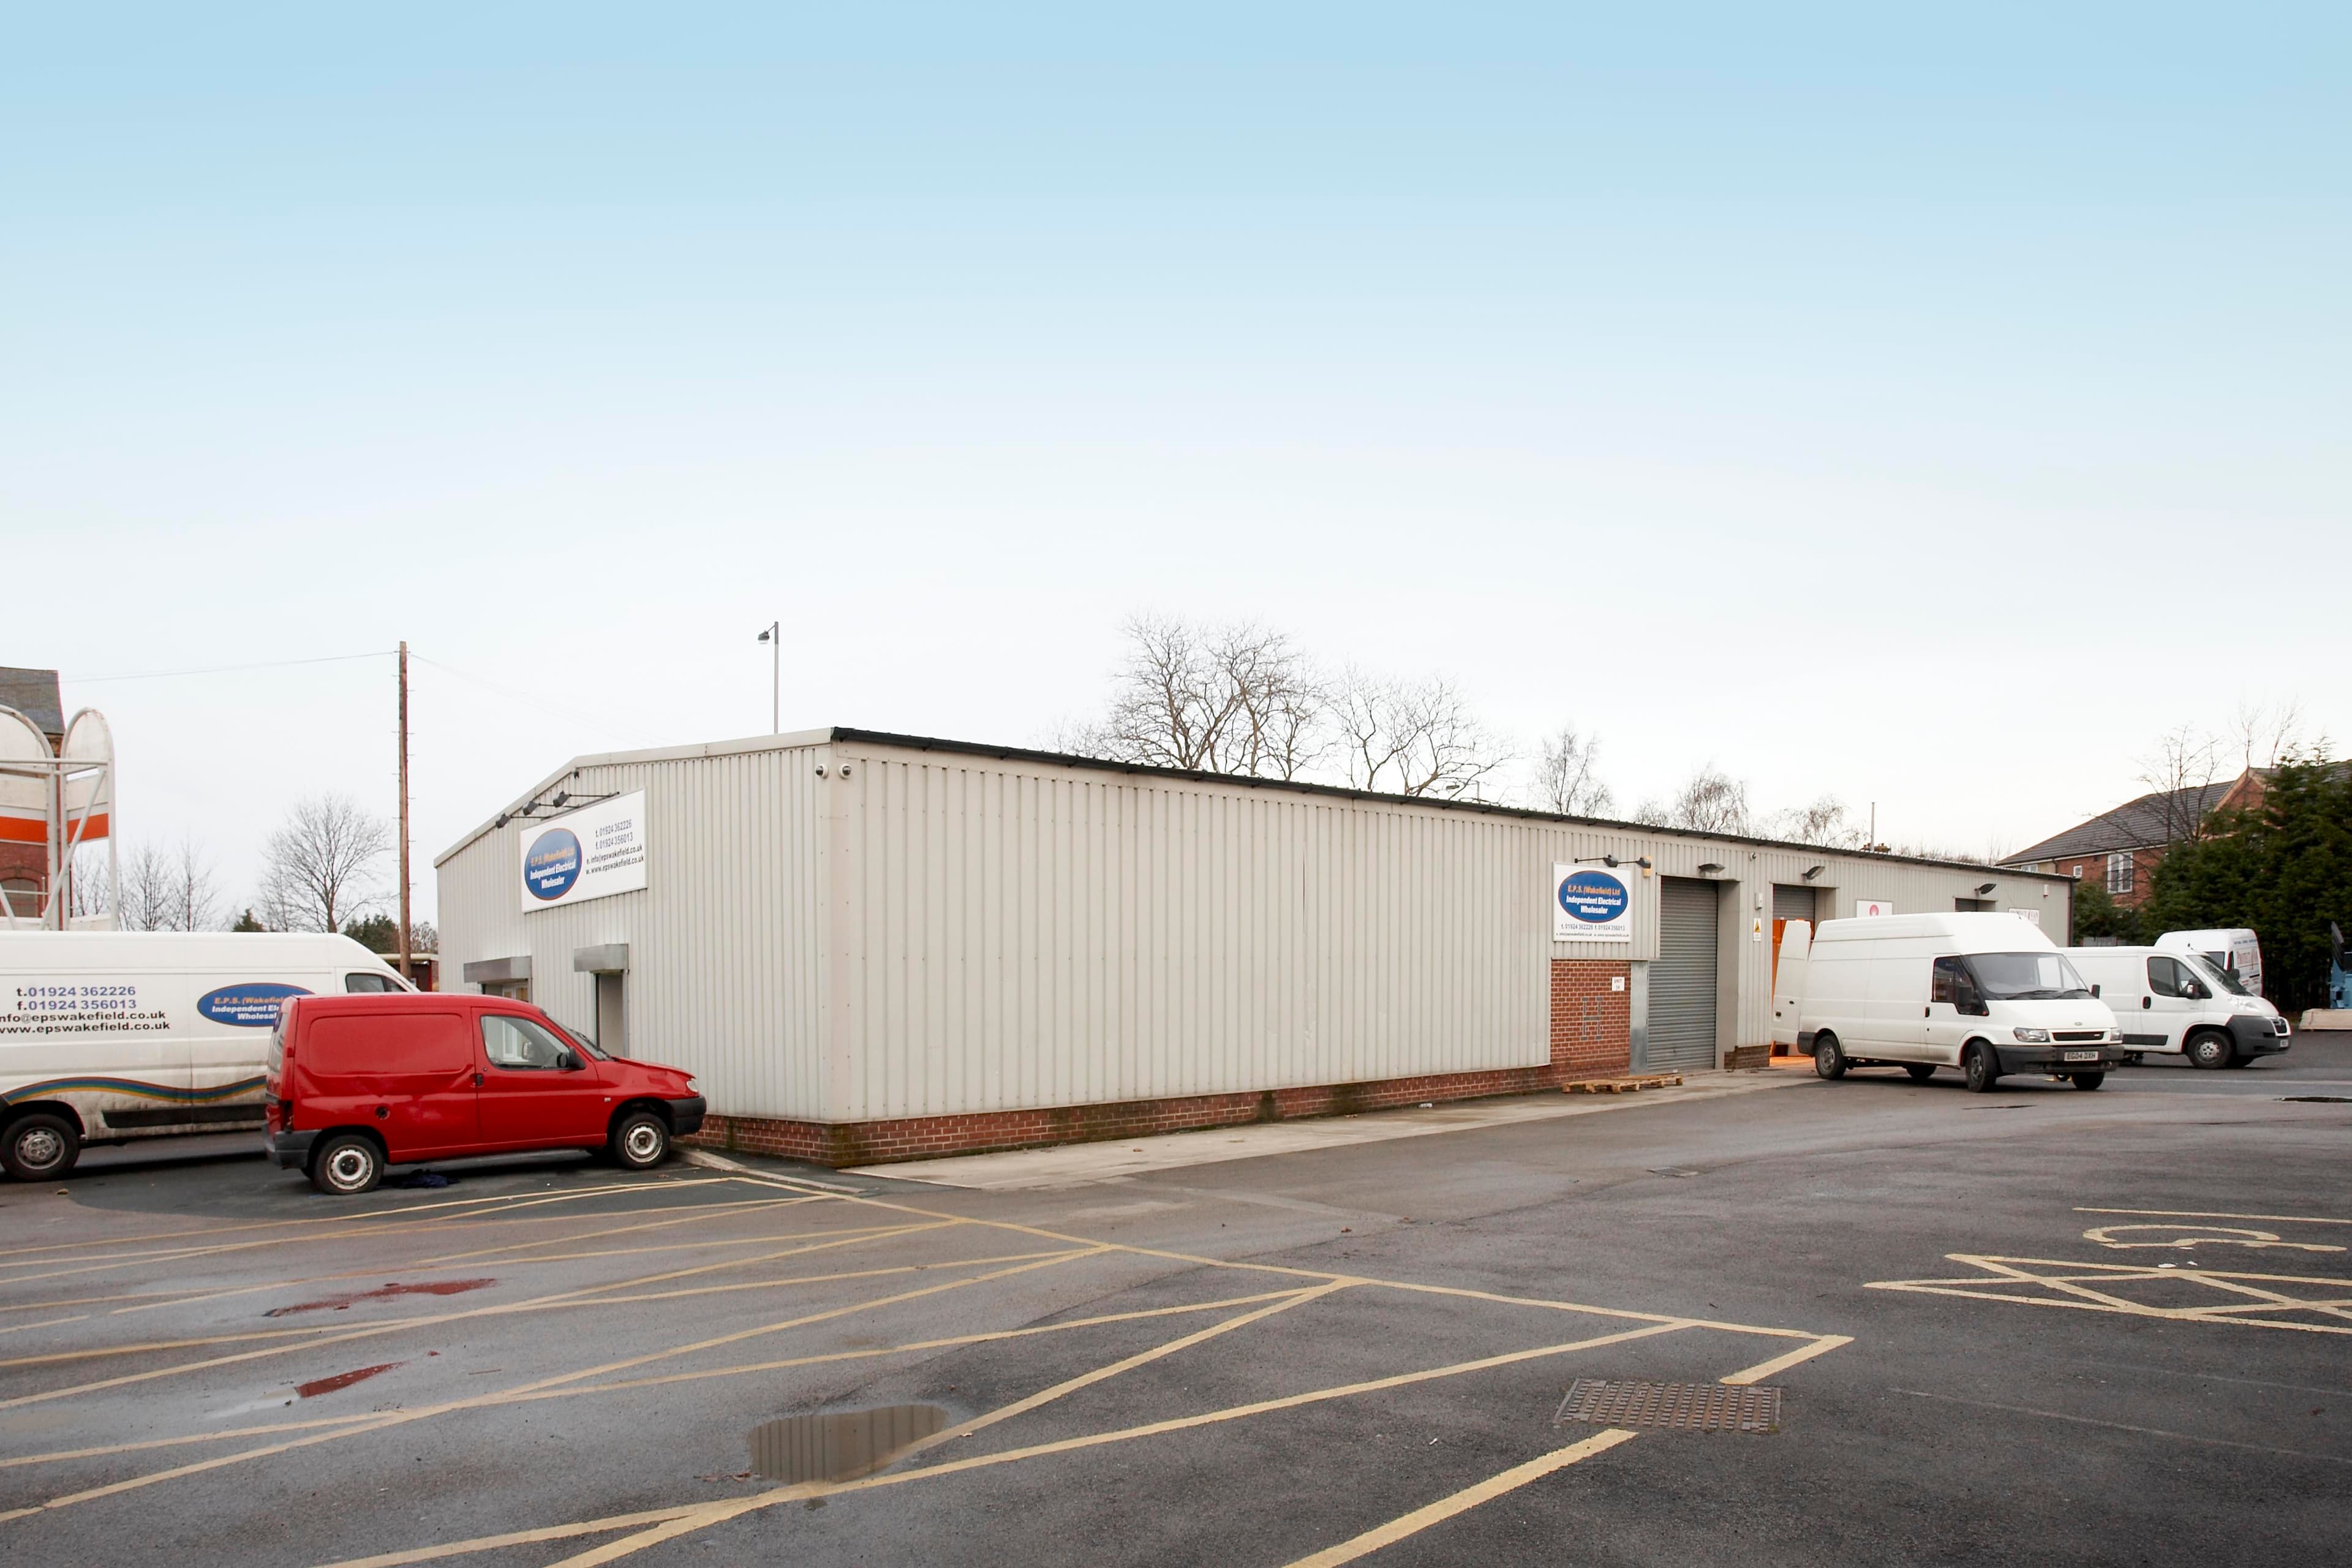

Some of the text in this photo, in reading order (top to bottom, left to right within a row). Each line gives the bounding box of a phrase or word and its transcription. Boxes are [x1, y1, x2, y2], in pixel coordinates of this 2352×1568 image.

[600, 824, 614, 837] 01924
[614, 819, 632, 832] 362226
[600, 838, 614, 849] 01924
[614, 832, 633, 845] 356013
[530, 858, 576, 880] Independent Electrical
[541, 875, 565, 889] Wholesaler
[1566, 895, 1621, 906] Independent Electrical
[1580, 905, 1608, 914] Wholesaler
[17, 986, 136, 997] t.01924 362226
[17, 1000, 137, 1010] f.01924 356013
[212, 1005, 266, 1014] Independent
[0, 1011, 166, 1023] nfo@epswakefield.co.uk
